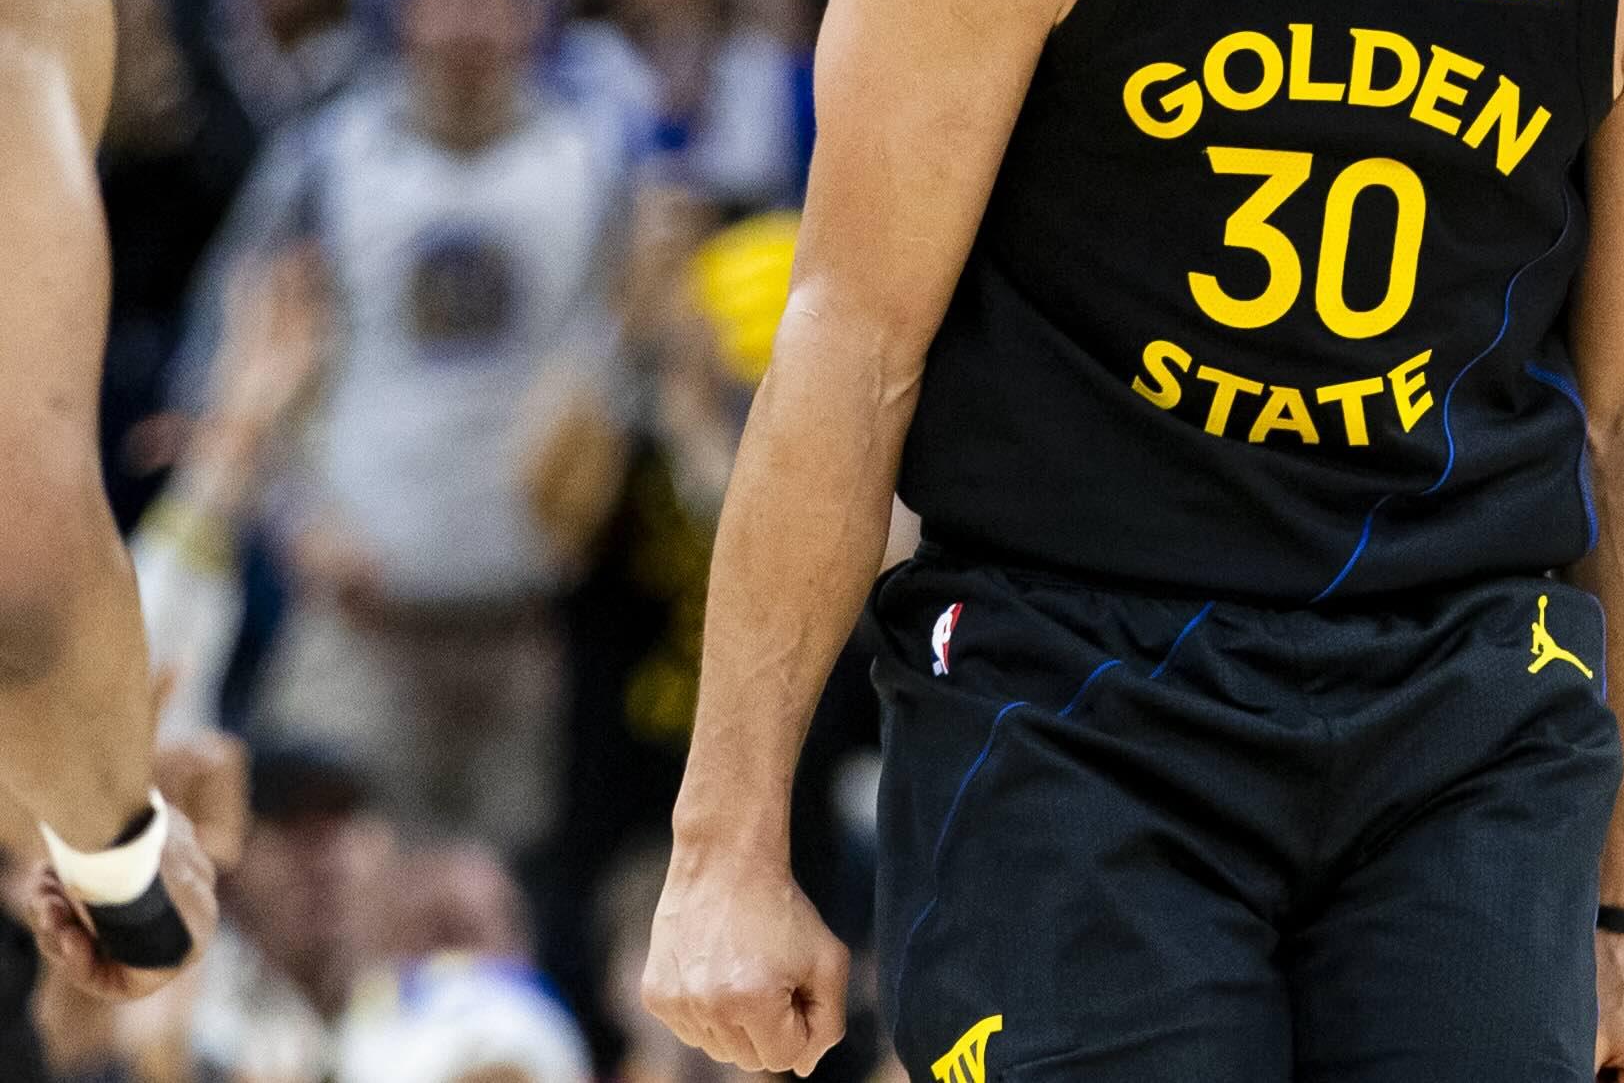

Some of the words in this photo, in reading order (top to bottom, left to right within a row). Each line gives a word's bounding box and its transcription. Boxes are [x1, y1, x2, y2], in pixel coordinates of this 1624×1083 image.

[1123, 24, 1551, 177] GOLDEN
[1188, 146, 1427, 339] 30
[1131, 340, 1433, 446] STATE
